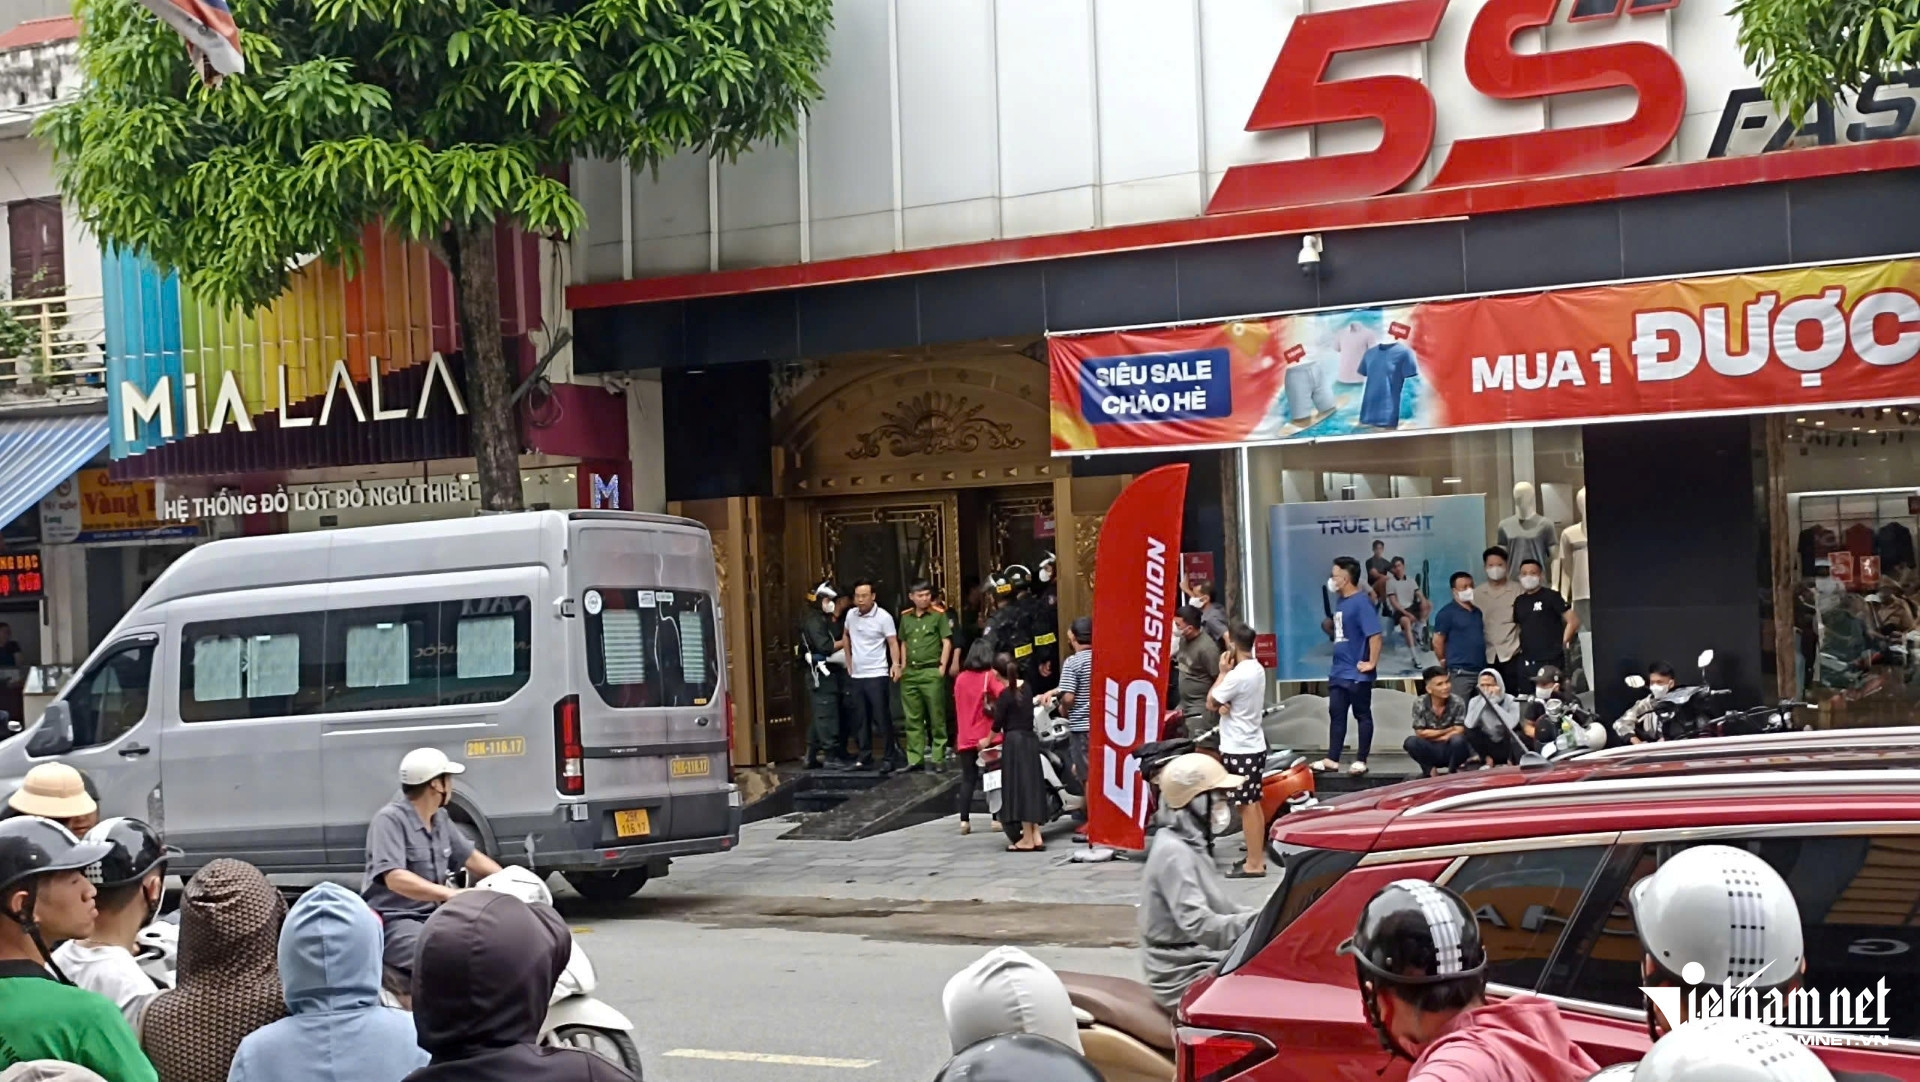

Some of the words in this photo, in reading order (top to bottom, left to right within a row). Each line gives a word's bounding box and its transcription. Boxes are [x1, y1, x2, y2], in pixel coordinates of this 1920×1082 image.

[1205, 0, 1687, 215] 5S
[1471, 349, 1586, 394] MUA
[1591, 347, 1612, 385] 1
[1632, 289, 1920, 388] ĐƯỢC
[278, 351, 467, 429] LALA
[1095, 361, 1149, 388] SIÊU
[1150, 359, 1212, 384] SALE
[1101, 389, 1171, 415] CHÀO
[1173, 386, 1207, 412] HÈ
[164, 494, 190, 523] HỆ
[192, 486, 257, 518] THỐNG
[260, 483, 289, 513] ĐỒ
[294, 484, 330, 511] LÓT
[590, 473, 619, 509] M
[1317, 518, 1370, 535] TRUE
[1373, 516, 1434, 533] LIGHT
[1143, 536, 1166, 678] FASHION
